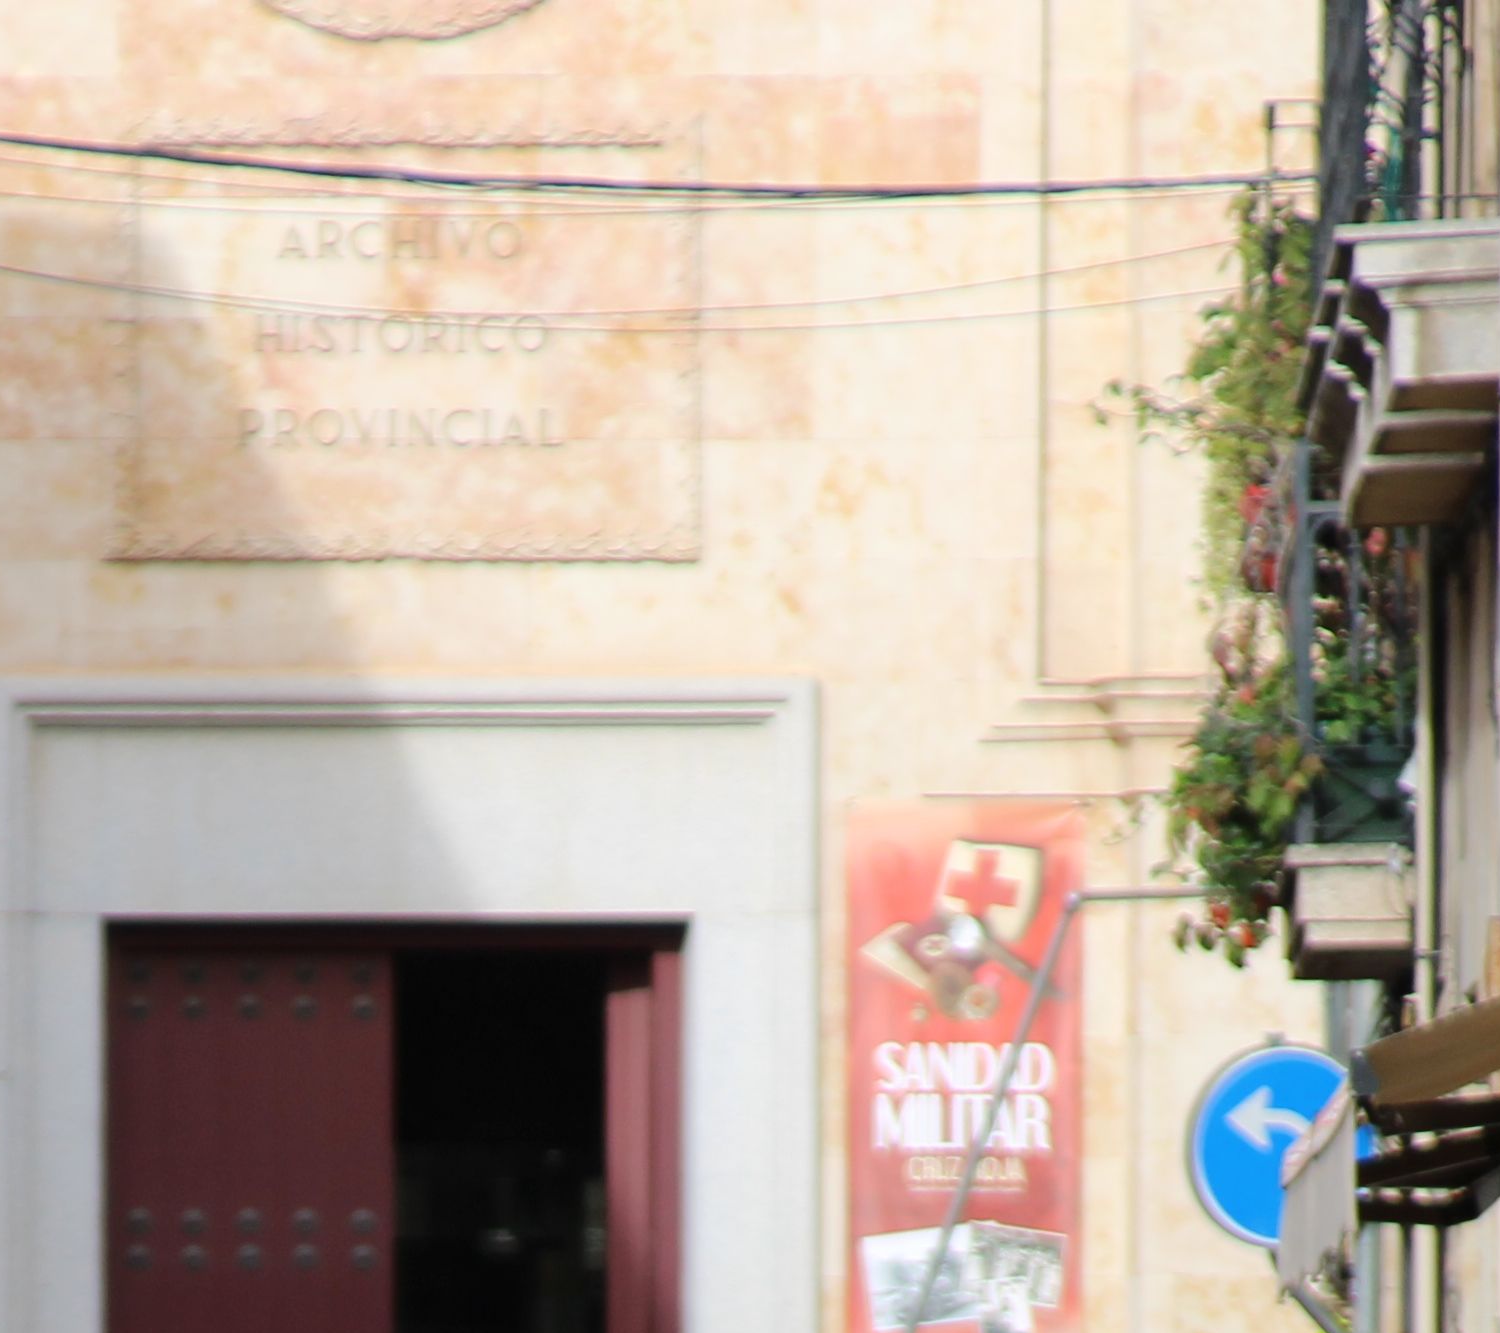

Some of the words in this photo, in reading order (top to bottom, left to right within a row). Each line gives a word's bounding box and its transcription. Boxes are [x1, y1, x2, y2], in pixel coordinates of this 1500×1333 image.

[277, 219, 523, 260] ARCHIVO
[253, 314, 549, 353] HISTORICO
[237, 407, 564, 447] PROVINCIAL
[873, 1041, 1056, 1092] SANIDAD
[873, 1092, 1052, 1150] MILITAR
[974, 1155, 1026, 1181] OJA
